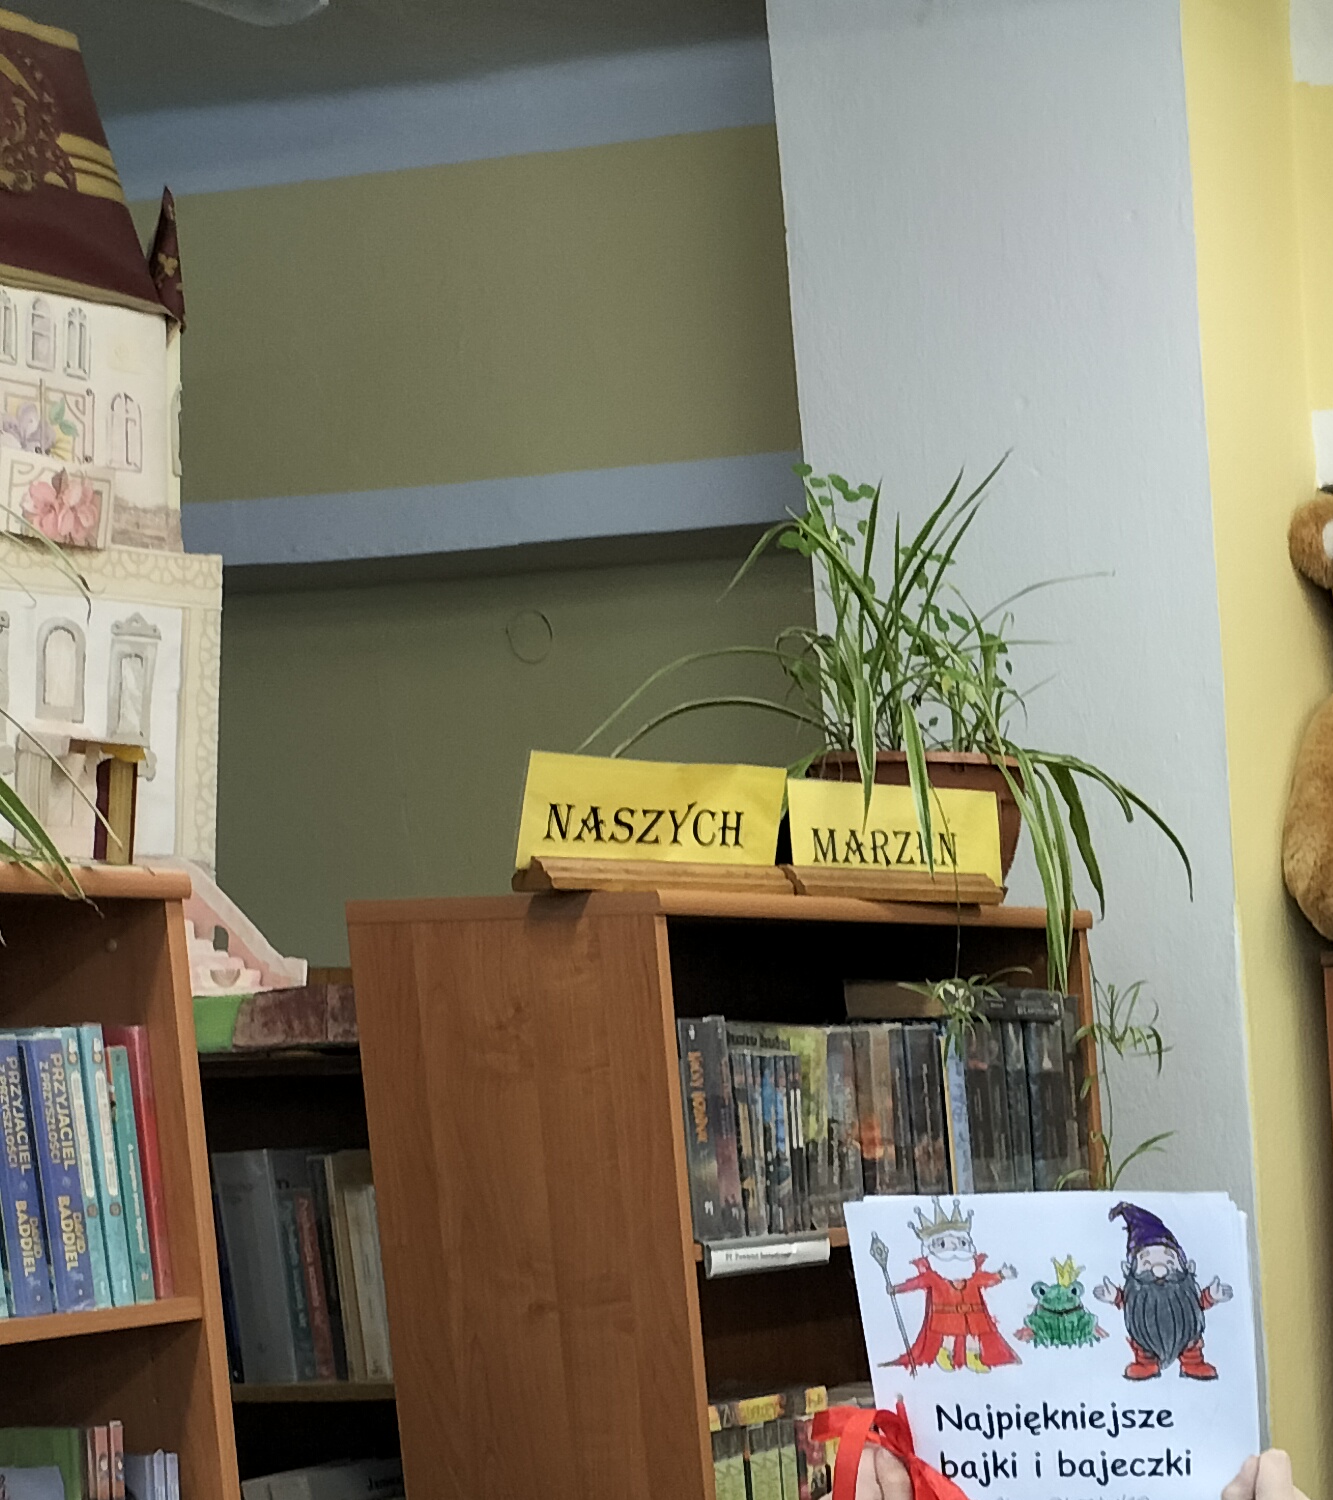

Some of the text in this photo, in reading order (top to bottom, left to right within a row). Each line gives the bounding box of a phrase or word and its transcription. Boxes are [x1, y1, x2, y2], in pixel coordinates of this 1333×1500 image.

[543, 802, 744, 848] NASZYCH
[6, 1056, 31, 1174] PRZYJACIEL
[50, 1053, 76, 1171] PRZYJACIEL
[15, 1200, 36, 1276] BADDIEL
[58, 1195, 79, 1271] BADDIEL
[936, 1402, 1174, 1440] Najpiękniejsze
[940, 1448, 1192, 1487] bajki i bajeczki
